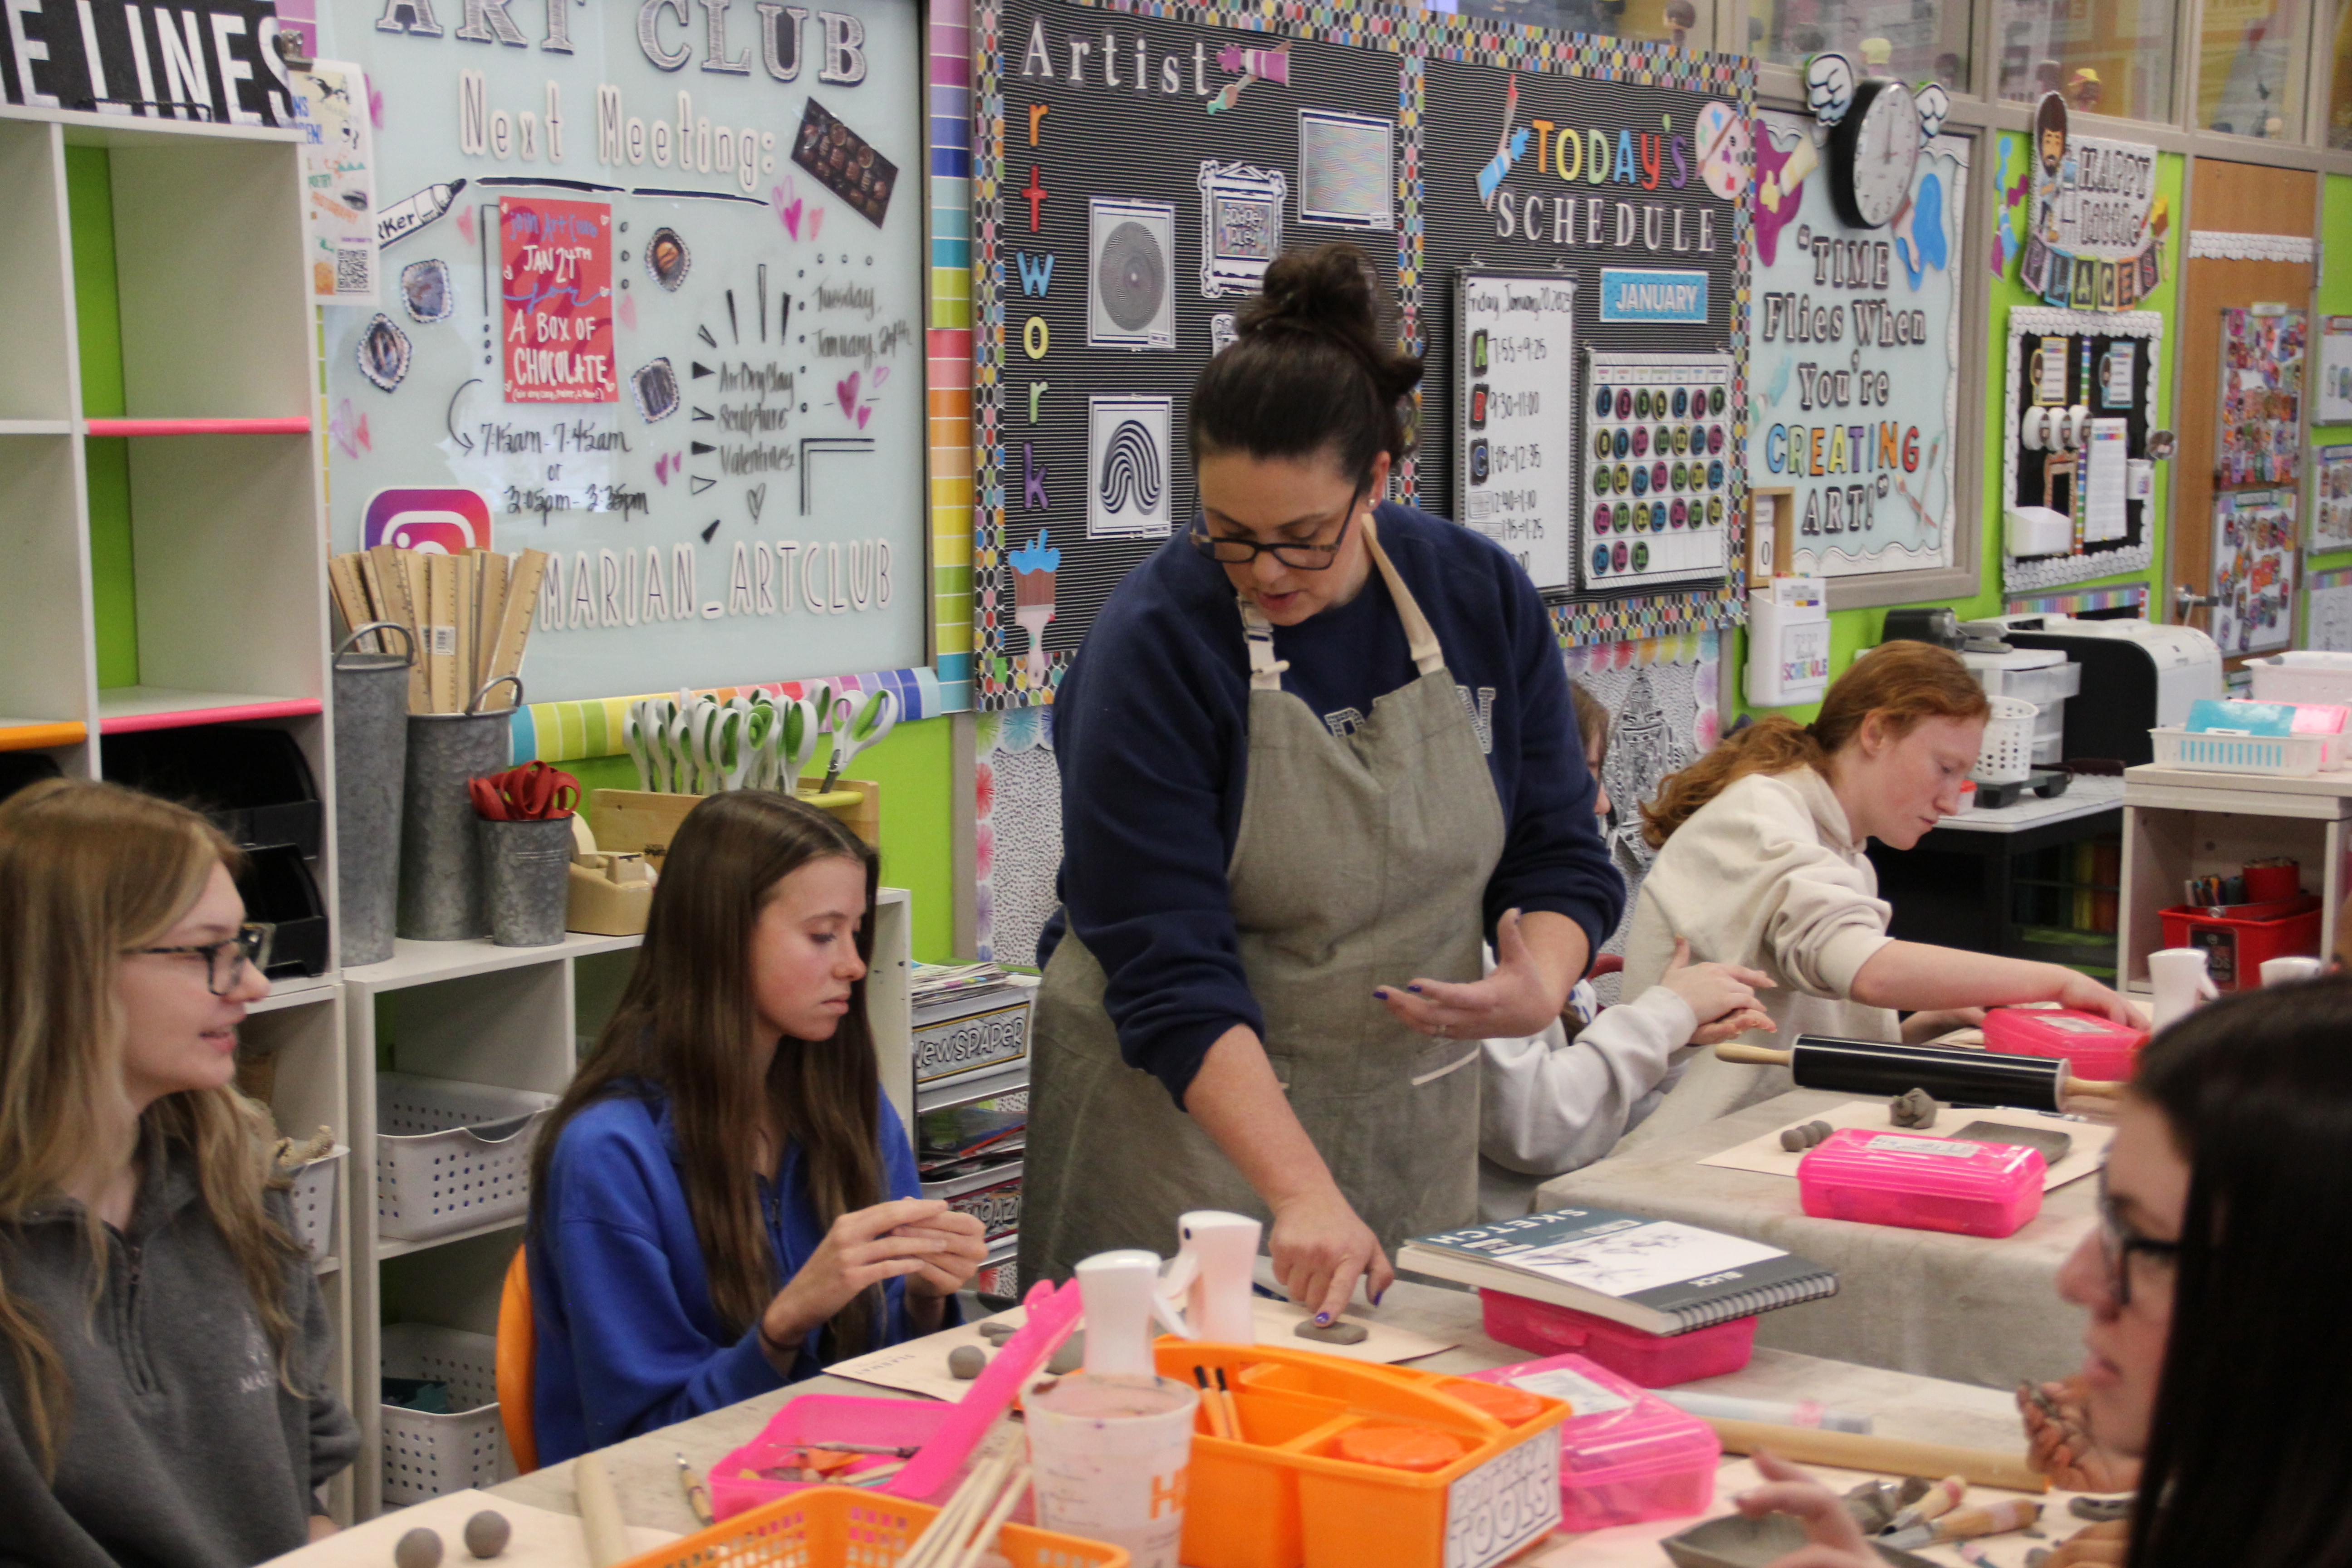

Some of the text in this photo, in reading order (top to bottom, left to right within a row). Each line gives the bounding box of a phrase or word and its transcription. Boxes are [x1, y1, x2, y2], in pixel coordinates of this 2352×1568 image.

[0, 0, 298, 128] E LINES
[636, 0, 867, 88] CLUB
[1022, 17, 1211, 97] Artist
[461, 70, 774, 190] Next Meeting:
[2079, 146, 2151, 200] HAPPY
[1497, 192, 1715, 252] SCHEDULE
[523, 245, 554, 274] JAN
[1616, 282, 1698, 313] JANUARY
[1764, 292, 1926, 347] Flies When
[508, 309, 597, 343] A BOX OF
[514, 347, 607, 387] CHOCOLATE
[1798, 349, 1890, 411] You're
[1473, 445, 1488, 476] C
[1767, 421, 1920, 477] CREATING
[1427, 1208, 1589, 1245] SKETCH
[1450, 1463, 1550, 1566] TOOLS
